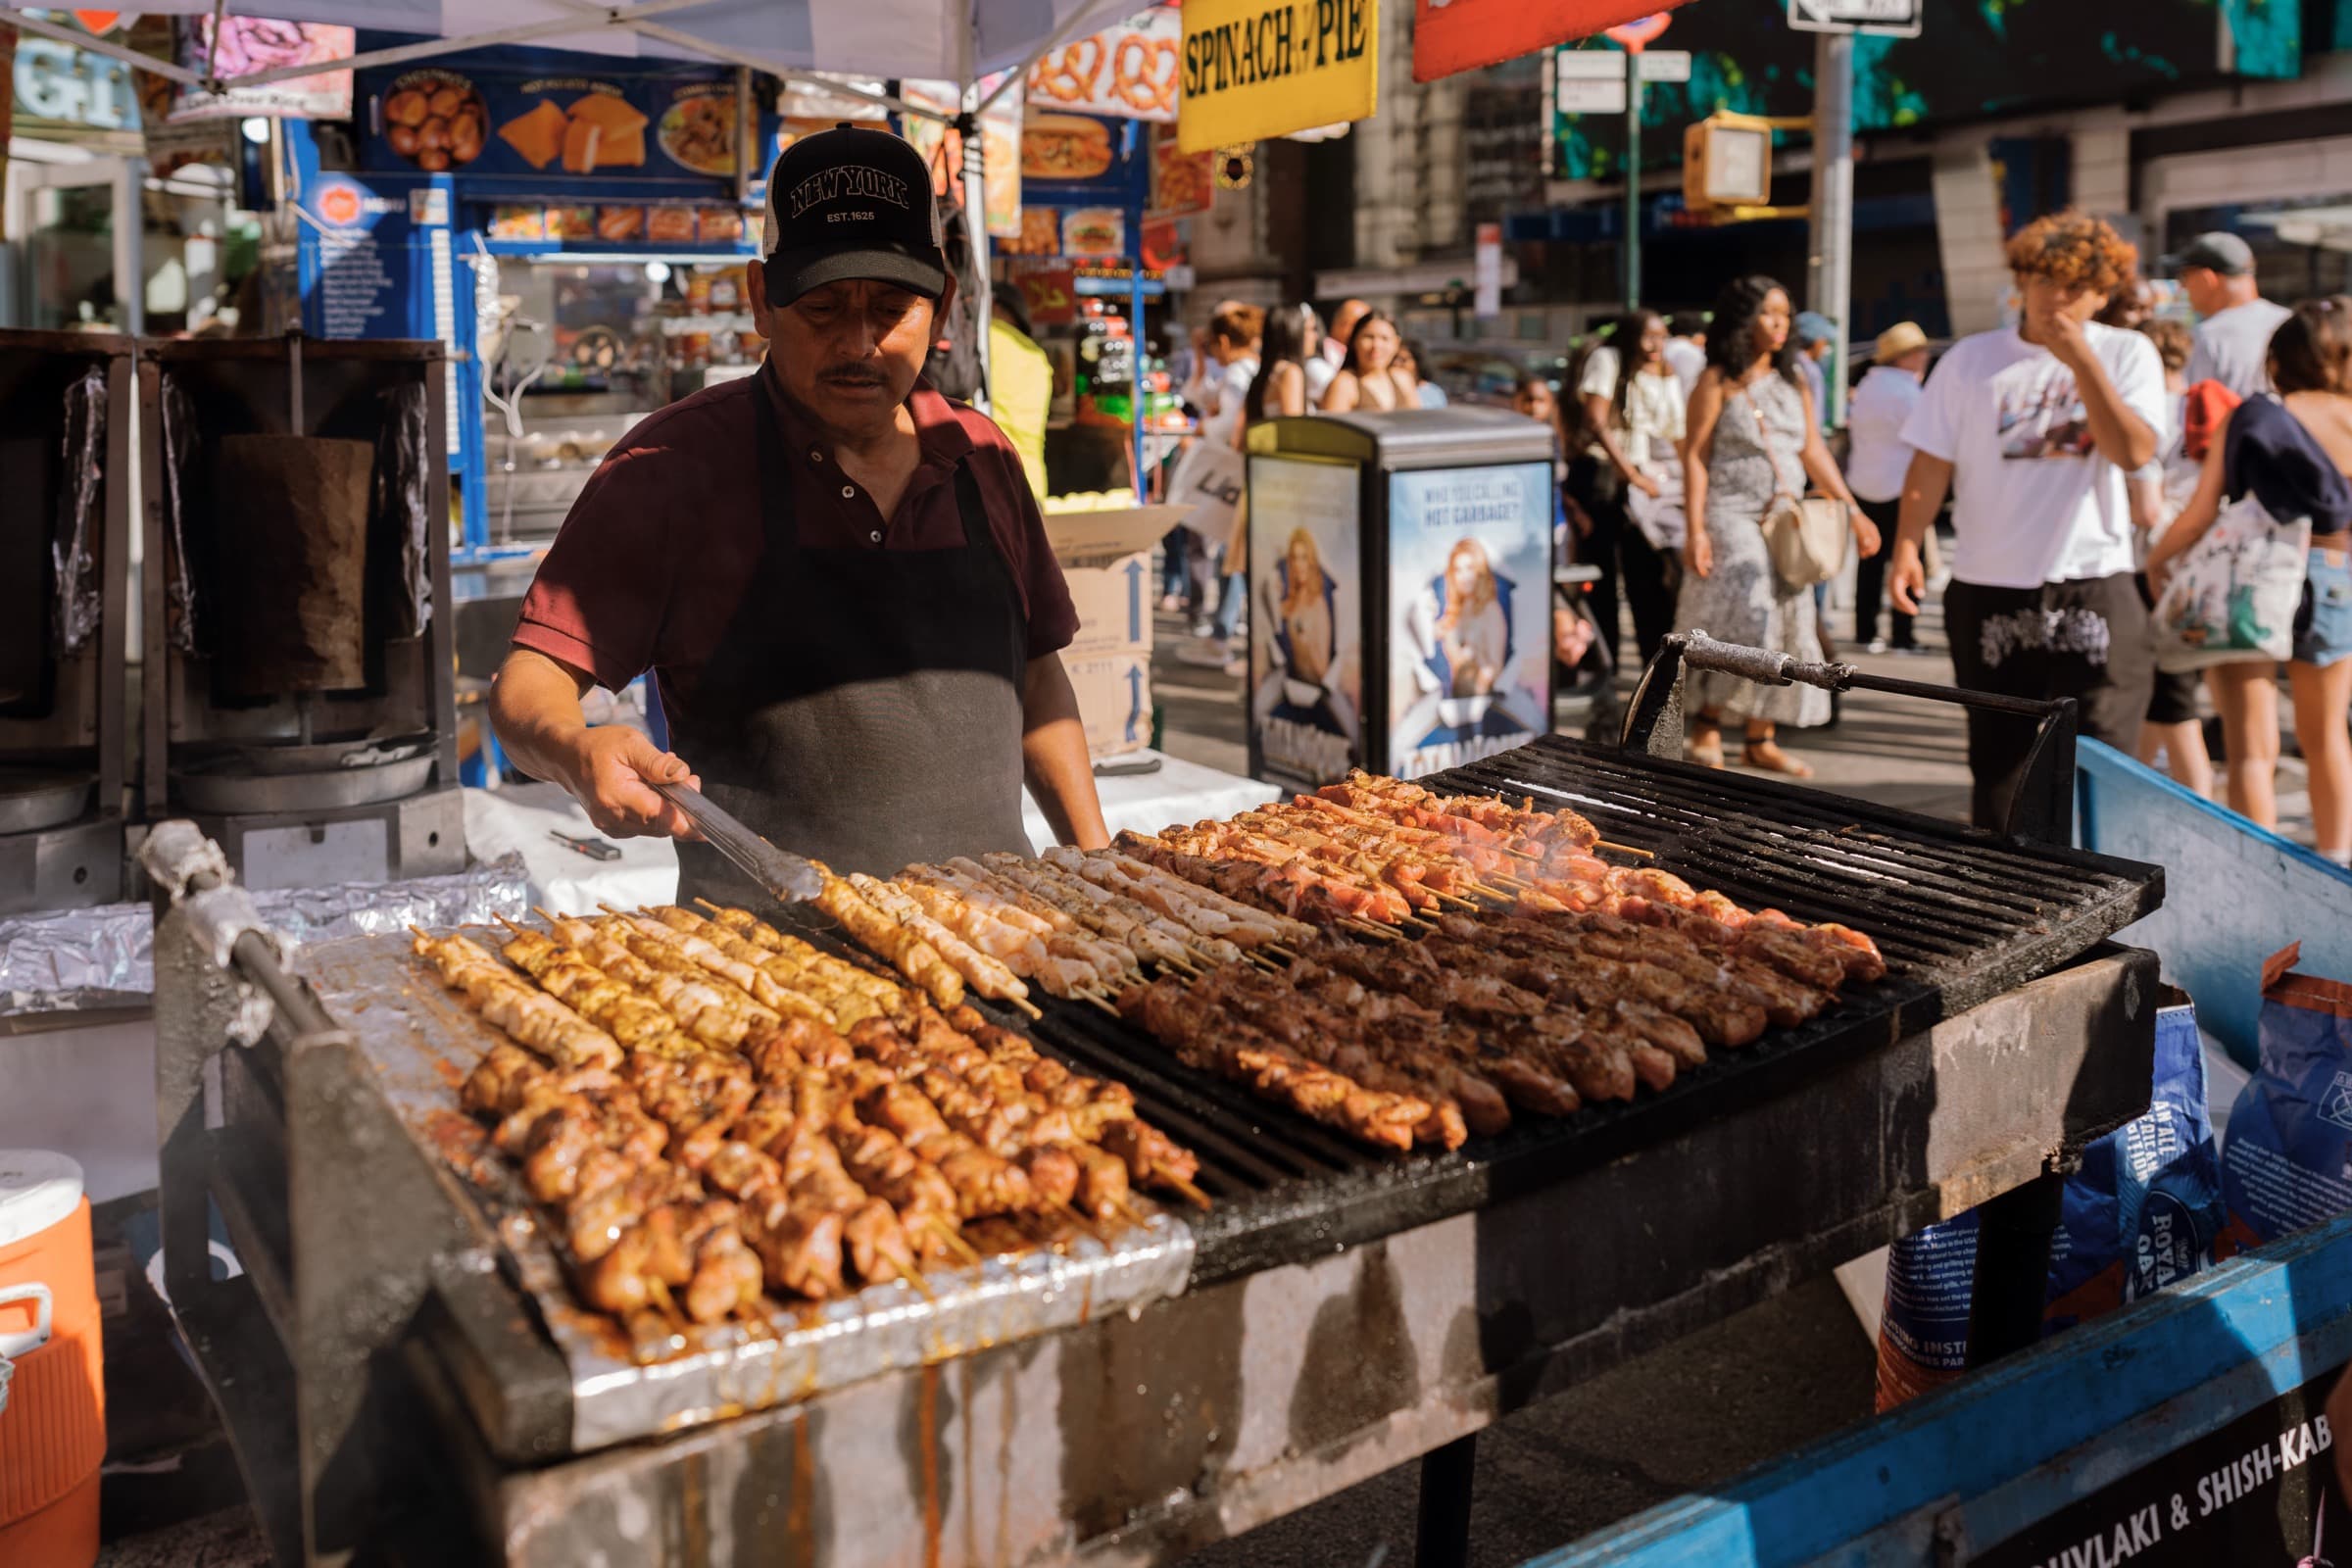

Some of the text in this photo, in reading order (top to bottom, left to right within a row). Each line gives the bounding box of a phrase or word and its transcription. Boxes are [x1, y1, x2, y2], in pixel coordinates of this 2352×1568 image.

[1185, 6, 1293, 98] SPINACH
[1316, 0, 1368, 67] PIE
[790, 165, 909, 219] NEW YORK
[2139, 1114, 2159, 1172] ERICAN
[2154, 1101, 2178, 1155] AN ALL
[1934, 1231, 1958, 1240] Charcoal
[1964, 1236, 1977, 1245] USA
[2170, 1493, 2191, 1531] &
